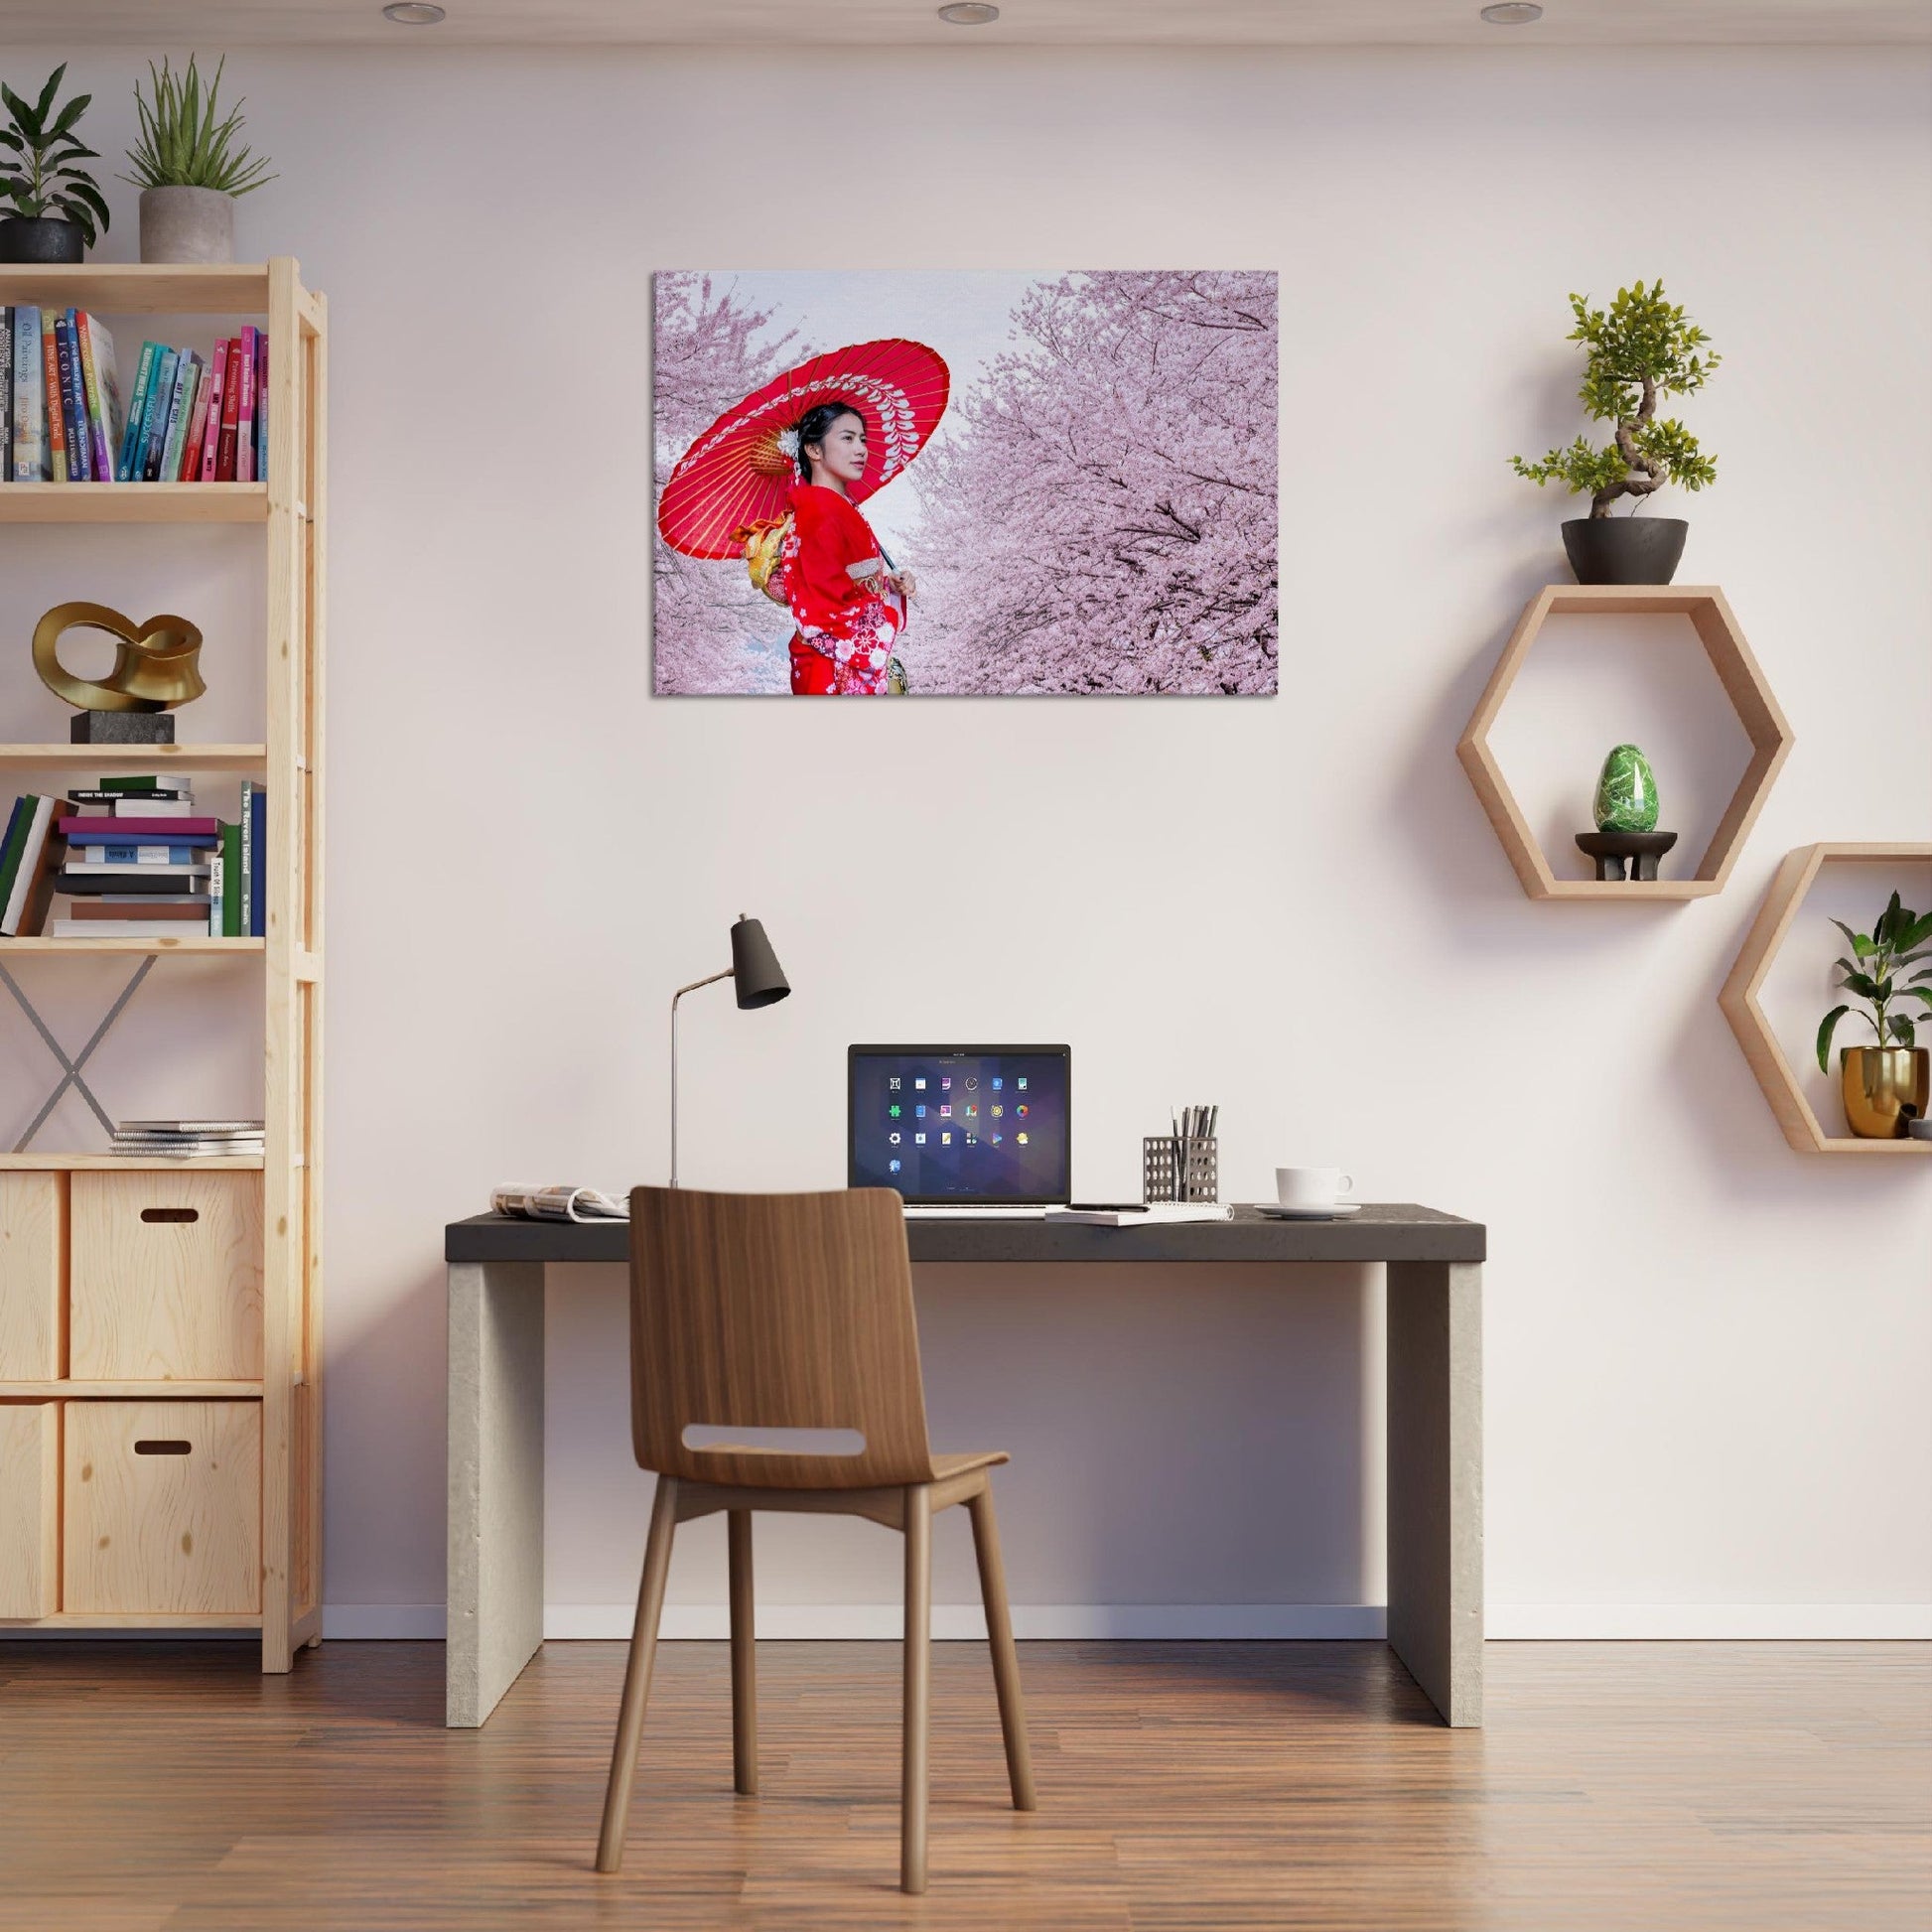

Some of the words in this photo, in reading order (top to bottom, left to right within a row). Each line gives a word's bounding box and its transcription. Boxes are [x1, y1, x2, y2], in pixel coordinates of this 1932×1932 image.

[22, 323, 32, 337] Oil
[19, 341, 33, 383] Paintings
[48, 362, 57, 376] ART
[72, 356, 81, 381] Beauty
[79, 324, 92, 370] Watercolor
[87, 372, 96, 409] Portraits
[59, 342, 72, 405] ICONIC
[228, 360, 239, 394] Parenting
[50, 381, 59, 398] With
[49, 399, 60, 422] Digital
[227, 394, 237, 413] Skills
[53, 423, 62, 439] Tools
[242, 788, 251, 808] The
